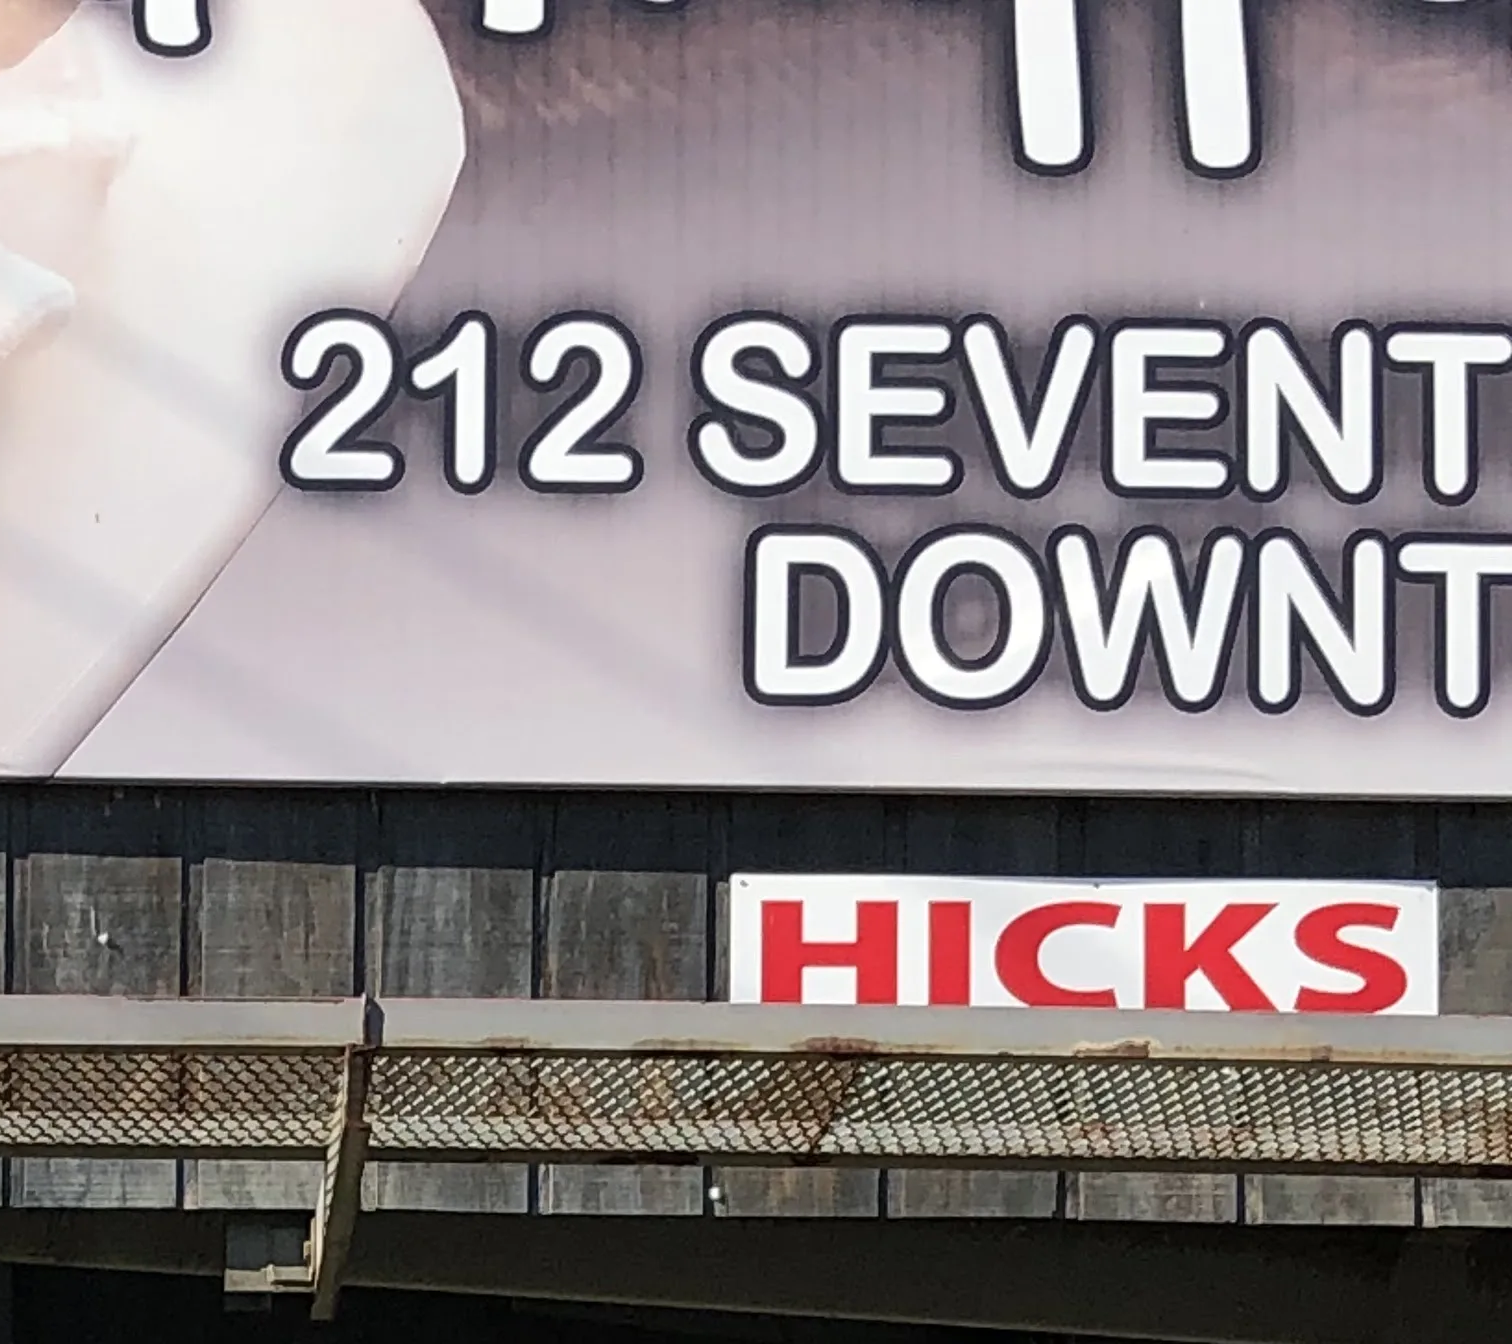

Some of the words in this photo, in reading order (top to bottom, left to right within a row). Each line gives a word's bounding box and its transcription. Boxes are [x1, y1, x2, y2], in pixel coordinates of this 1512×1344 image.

[285, 310, 642, 491] 212
[690, 310, 1512, 505] SEVENT
[743, 524, 1512, 718] DOWNT
[760, 900, 1408, 1014] HICKS
